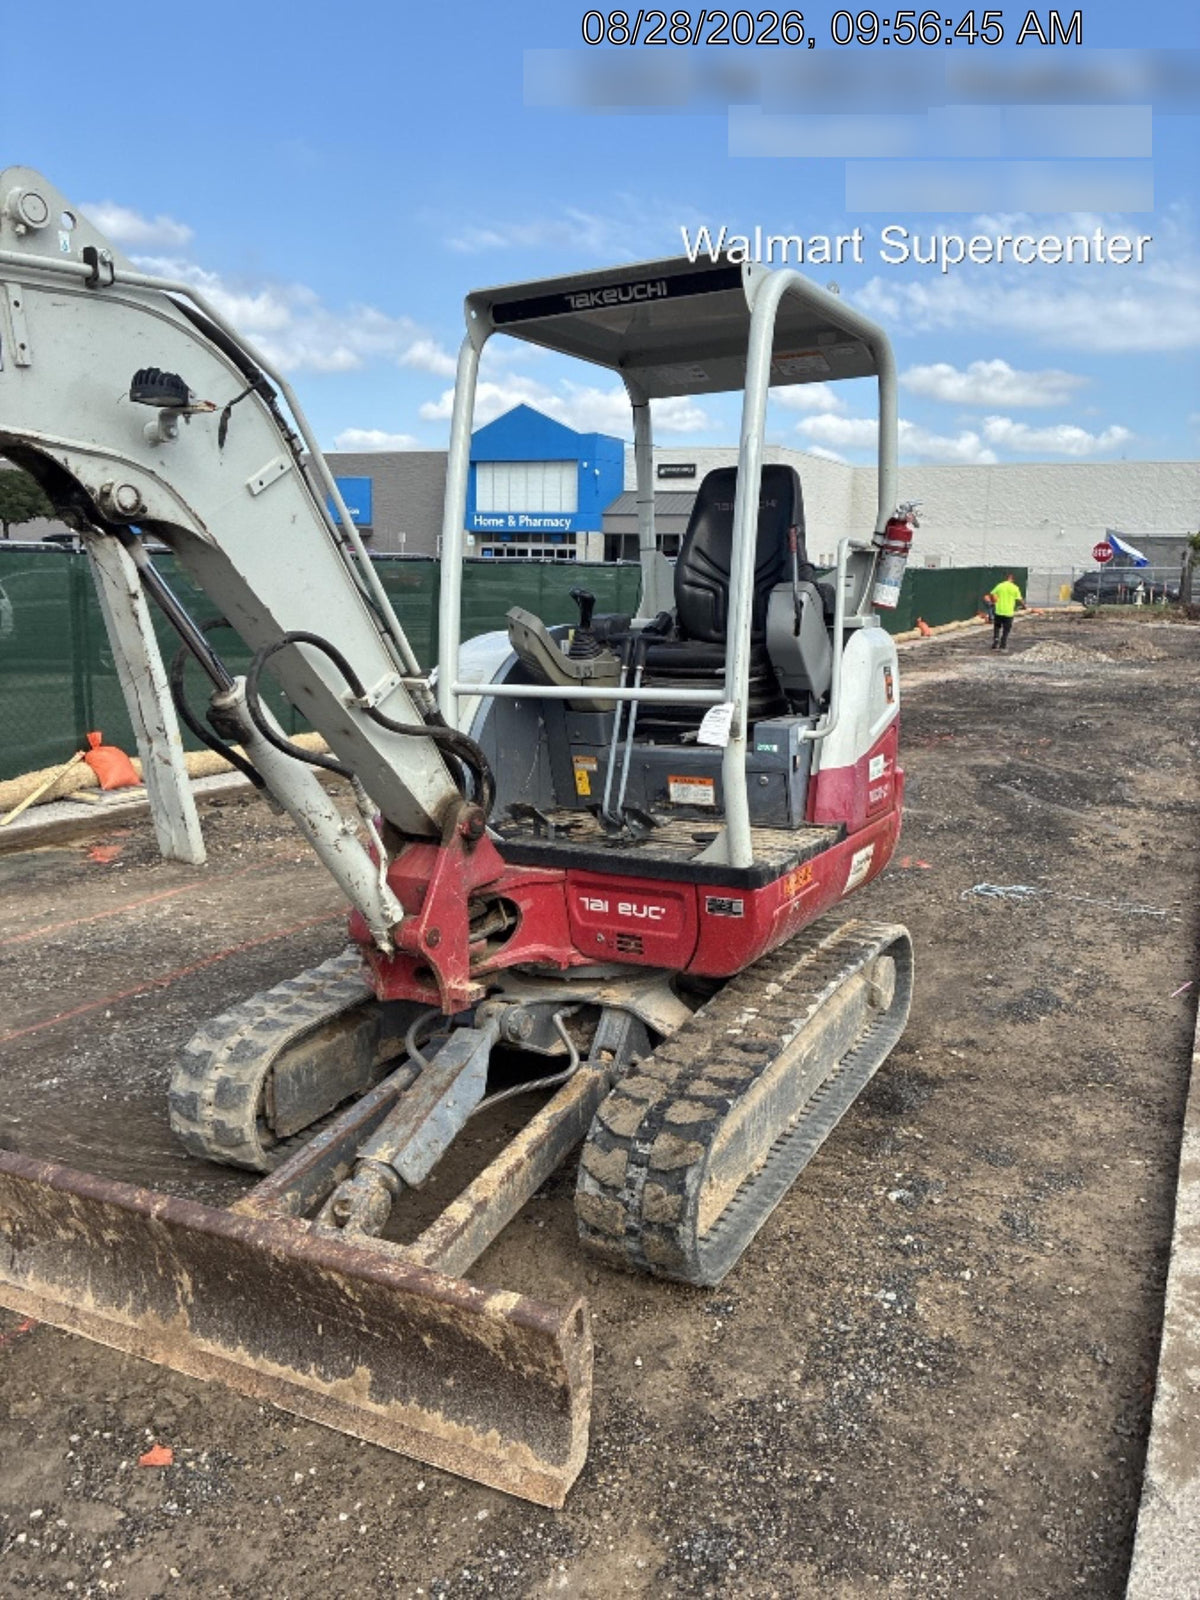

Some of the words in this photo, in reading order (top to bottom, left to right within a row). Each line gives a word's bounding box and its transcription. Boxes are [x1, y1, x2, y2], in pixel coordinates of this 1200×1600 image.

[474, 514, 505, 527] Home
[507, 514, 517, 527] &
[518, 514, 572, 531] Pharmacy
